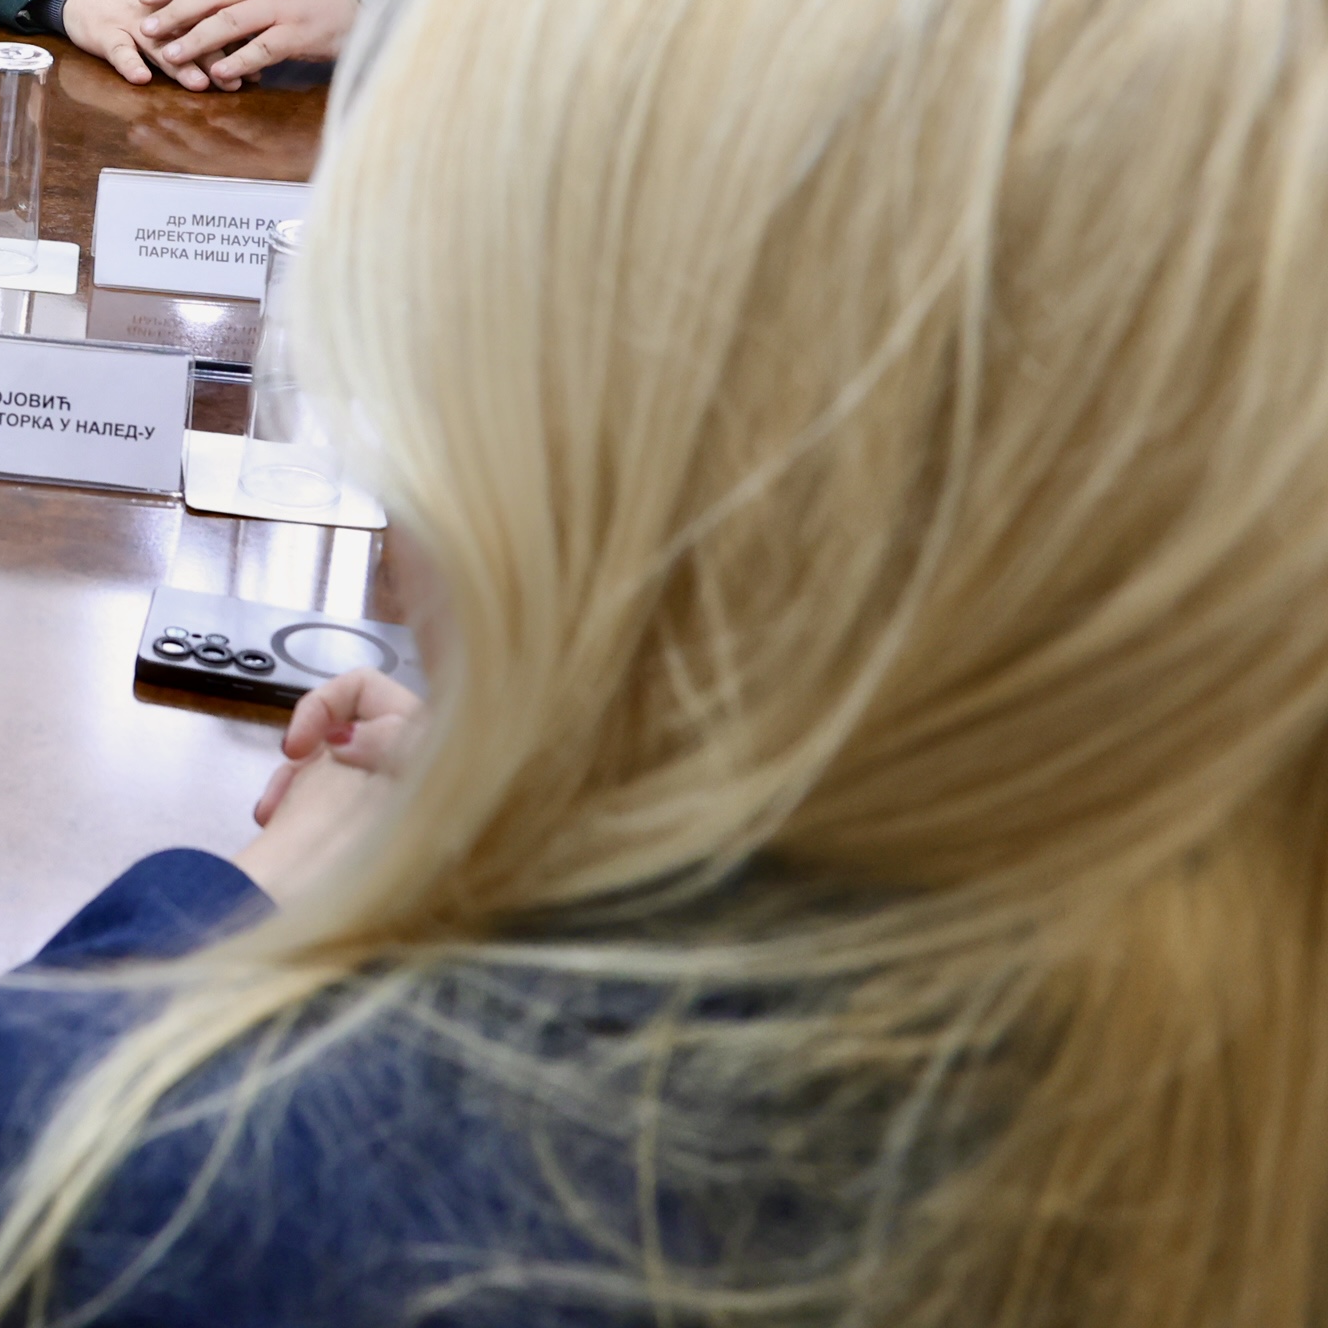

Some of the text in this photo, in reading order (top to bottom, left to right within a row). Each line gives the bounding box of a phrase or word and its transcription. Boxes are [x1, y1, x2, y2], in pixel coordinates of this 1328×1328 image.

[166, 215, 187, 228] др
[191, 214, 251, 230] МИЛАН
[134, 228, 216, 245] ДИРЕКТОР
[138, 245, 190, 261] ПАРКА
[194, 249, 230, 263] НИШ
[234, 252, 245, 264] И
[59, 418, 72, 432] У
[75, 419, 157, 441] НАЛЕД-У
